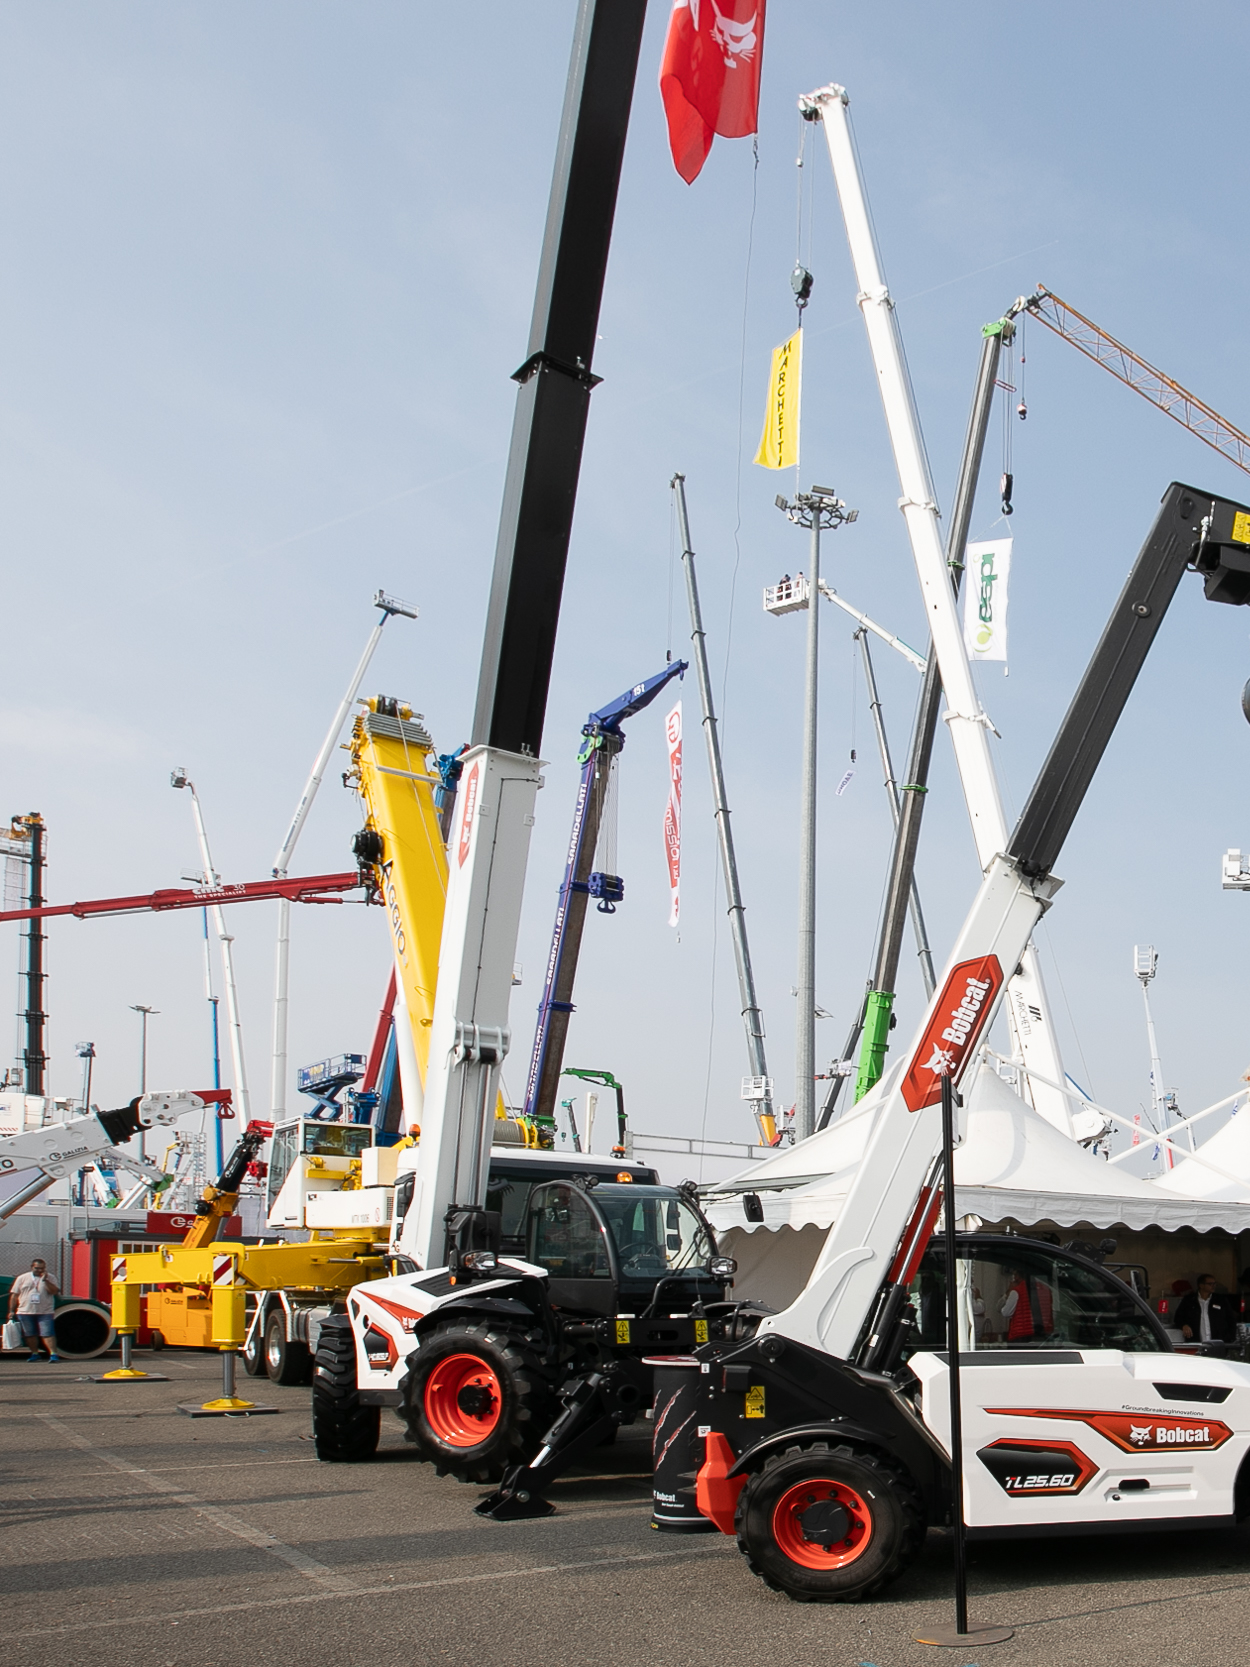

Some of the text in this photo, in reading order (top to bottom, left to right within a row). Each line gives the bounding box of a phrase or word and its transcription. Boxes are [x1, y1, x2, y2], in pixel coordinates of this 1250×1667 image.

[777, 341, 792, 466] MARCHETTI
[466, 776, 477, 823] Bobcat
[941, 977, 990, 1047] Bobcat
[1014, 990, 1031, 1036] MARCHETTI
[62, 1146, 88, 1158] GALIZIA
[1121, 1404, 1205, 1417] #GroundbreakingInnovations
[1156, 1426, 1210, 1443] Bobcat
[1005, 1474, 1075, 1489] TL25.60
